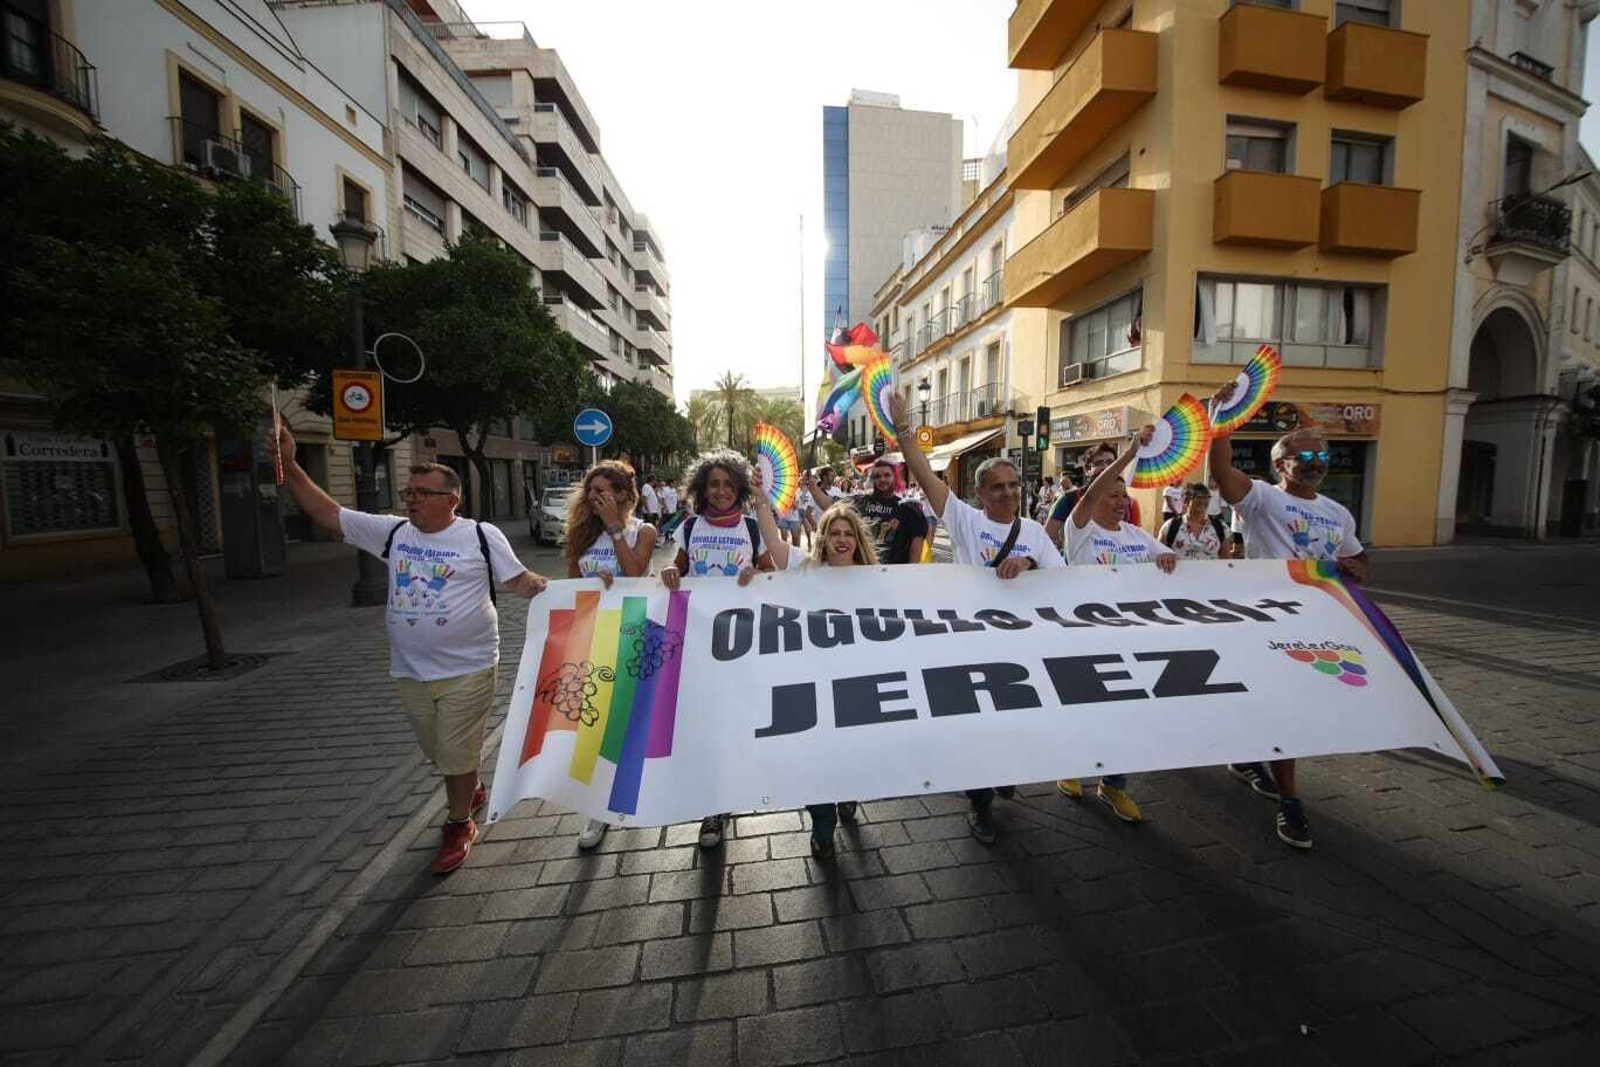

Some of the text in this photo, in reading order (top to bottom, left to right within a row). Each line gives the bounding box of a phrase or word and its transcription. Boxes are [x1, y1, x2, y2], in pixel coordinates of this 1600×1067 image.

[1344, 406, 1374, 421] ORO
[20, 442, 99, 457] Corredera
[711, 598, 1305, 661] ORGULLO LGTBI+
[754, 648, 1249, 738] JEREZ
